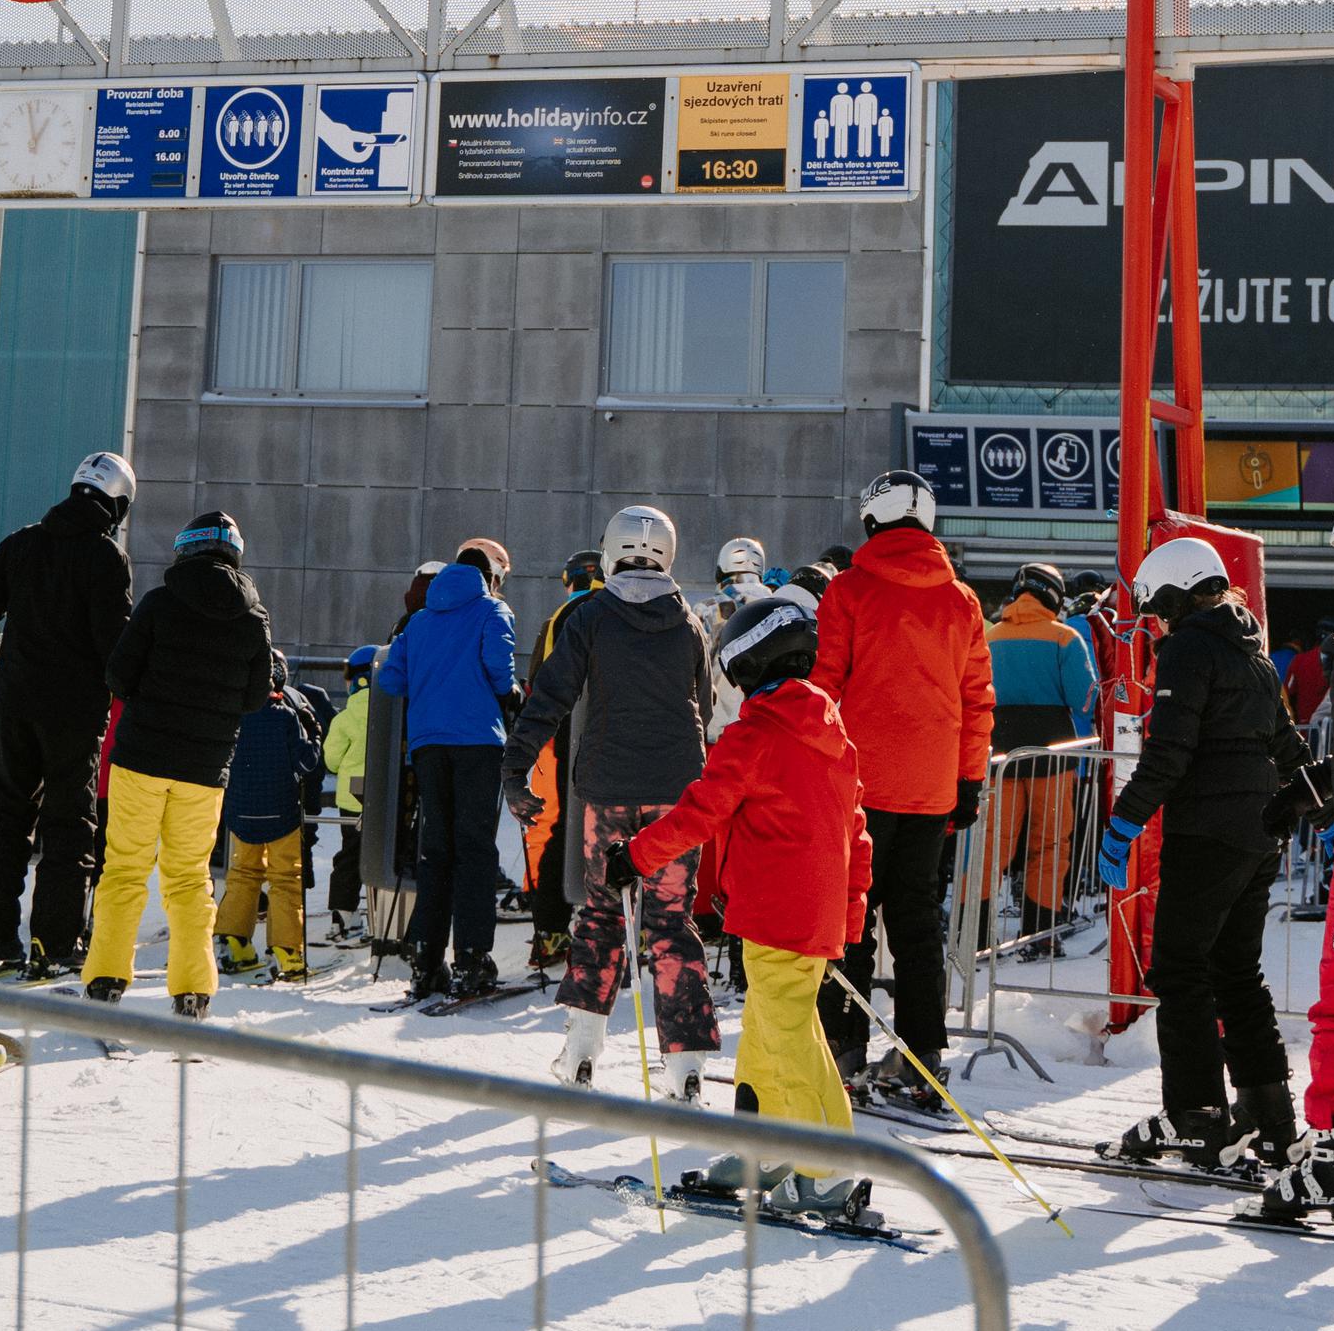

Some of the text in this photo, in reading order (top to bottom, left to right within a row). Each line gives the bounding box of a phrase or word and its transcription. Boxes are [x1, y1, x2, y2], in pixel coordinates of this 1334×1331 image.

[707, 80, 762, 92] Uzavření
[106, 88, 183, 99] Provozní doba
[684, 94, 784, 109] sjezdových tratí
[97, 126, 180, 138] Začátek 8.00
[95, 149, 181, 162] Konec 16.00
[219, 172, 280, 180] Utvořte čtveřice
[321, 167, 374, 176] Kontrolní zóna
[702, 160, 758, 180] 16:30
[1155, 1137, 1206, 1148] HEAD
